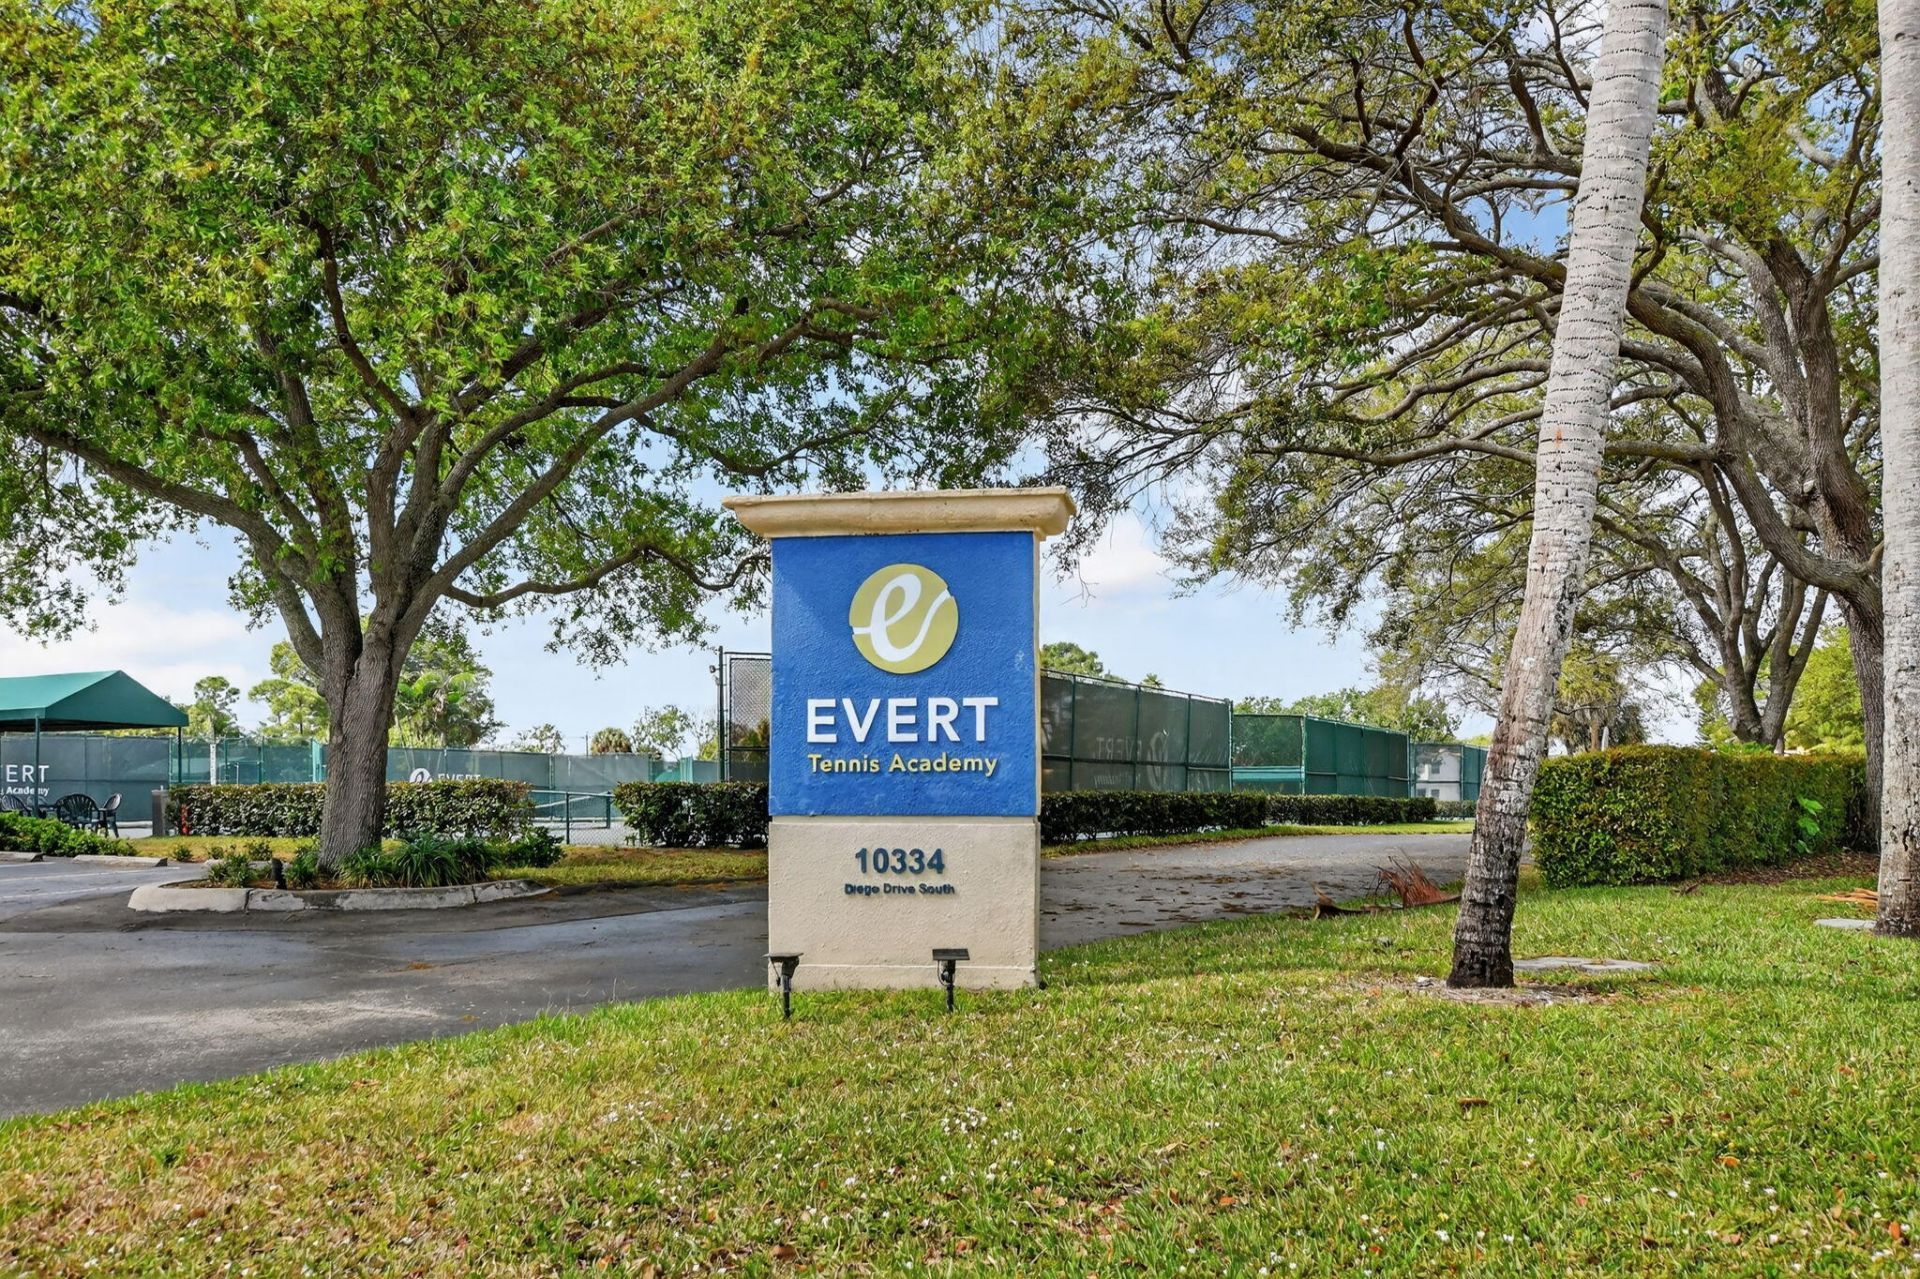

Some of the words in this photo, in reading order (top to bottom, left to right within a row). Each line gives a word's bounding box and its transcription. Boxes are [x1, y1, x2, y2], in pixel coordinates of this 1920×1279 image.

[807, 697, 999, 743] EVERT
[0, 764, 50, 783] ERT
[807, 753, 880, 773] Tennis
[888, 752, 998, 777] Academy
[855, 847, 945, 875] 10334
[844, 883, 880, 896] Diego
[883, 883, 916, 894] Drive
[919, 883, 955, 894] South
